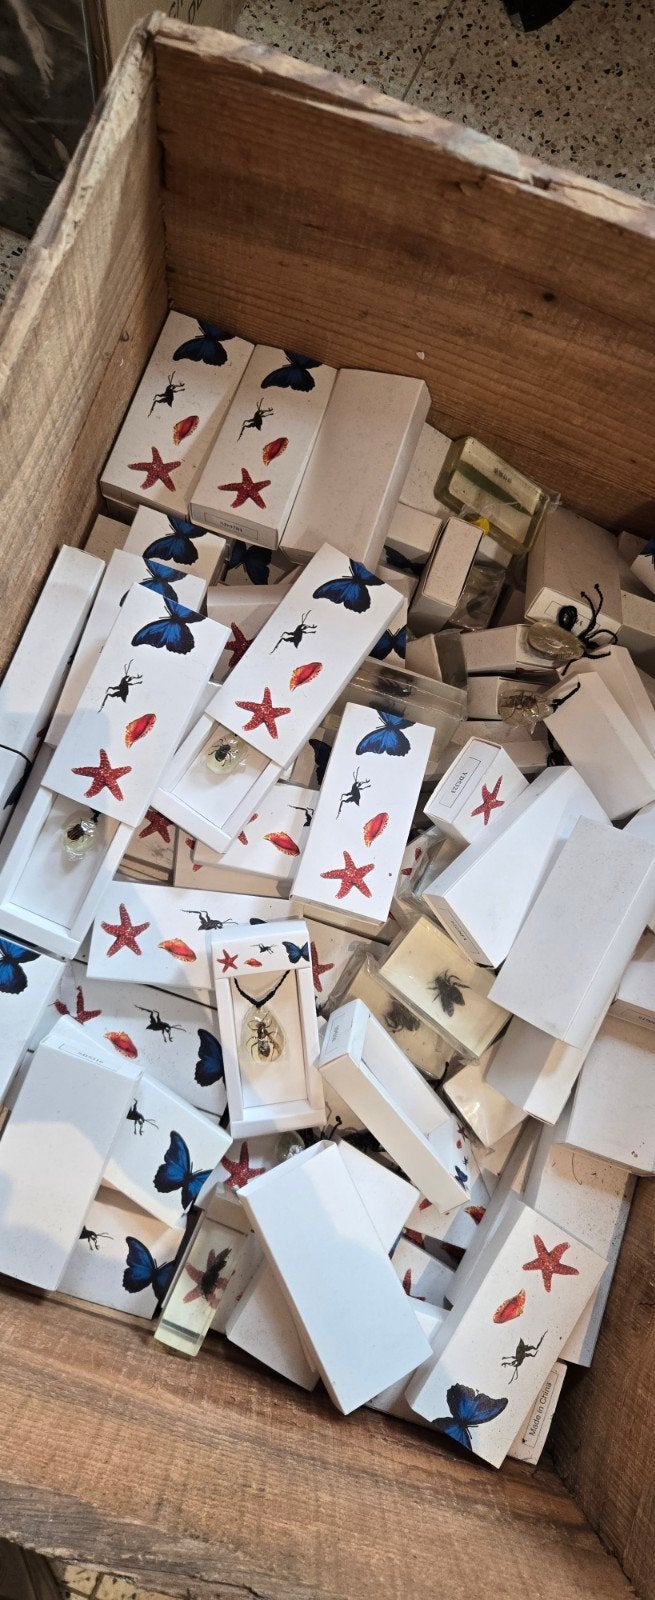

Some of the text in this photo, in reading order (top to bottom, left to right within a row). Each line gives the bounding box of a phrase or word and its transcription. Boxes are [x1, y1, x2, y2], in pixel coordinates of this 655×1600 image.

[529, 1382, 552, 1436] Made in China
